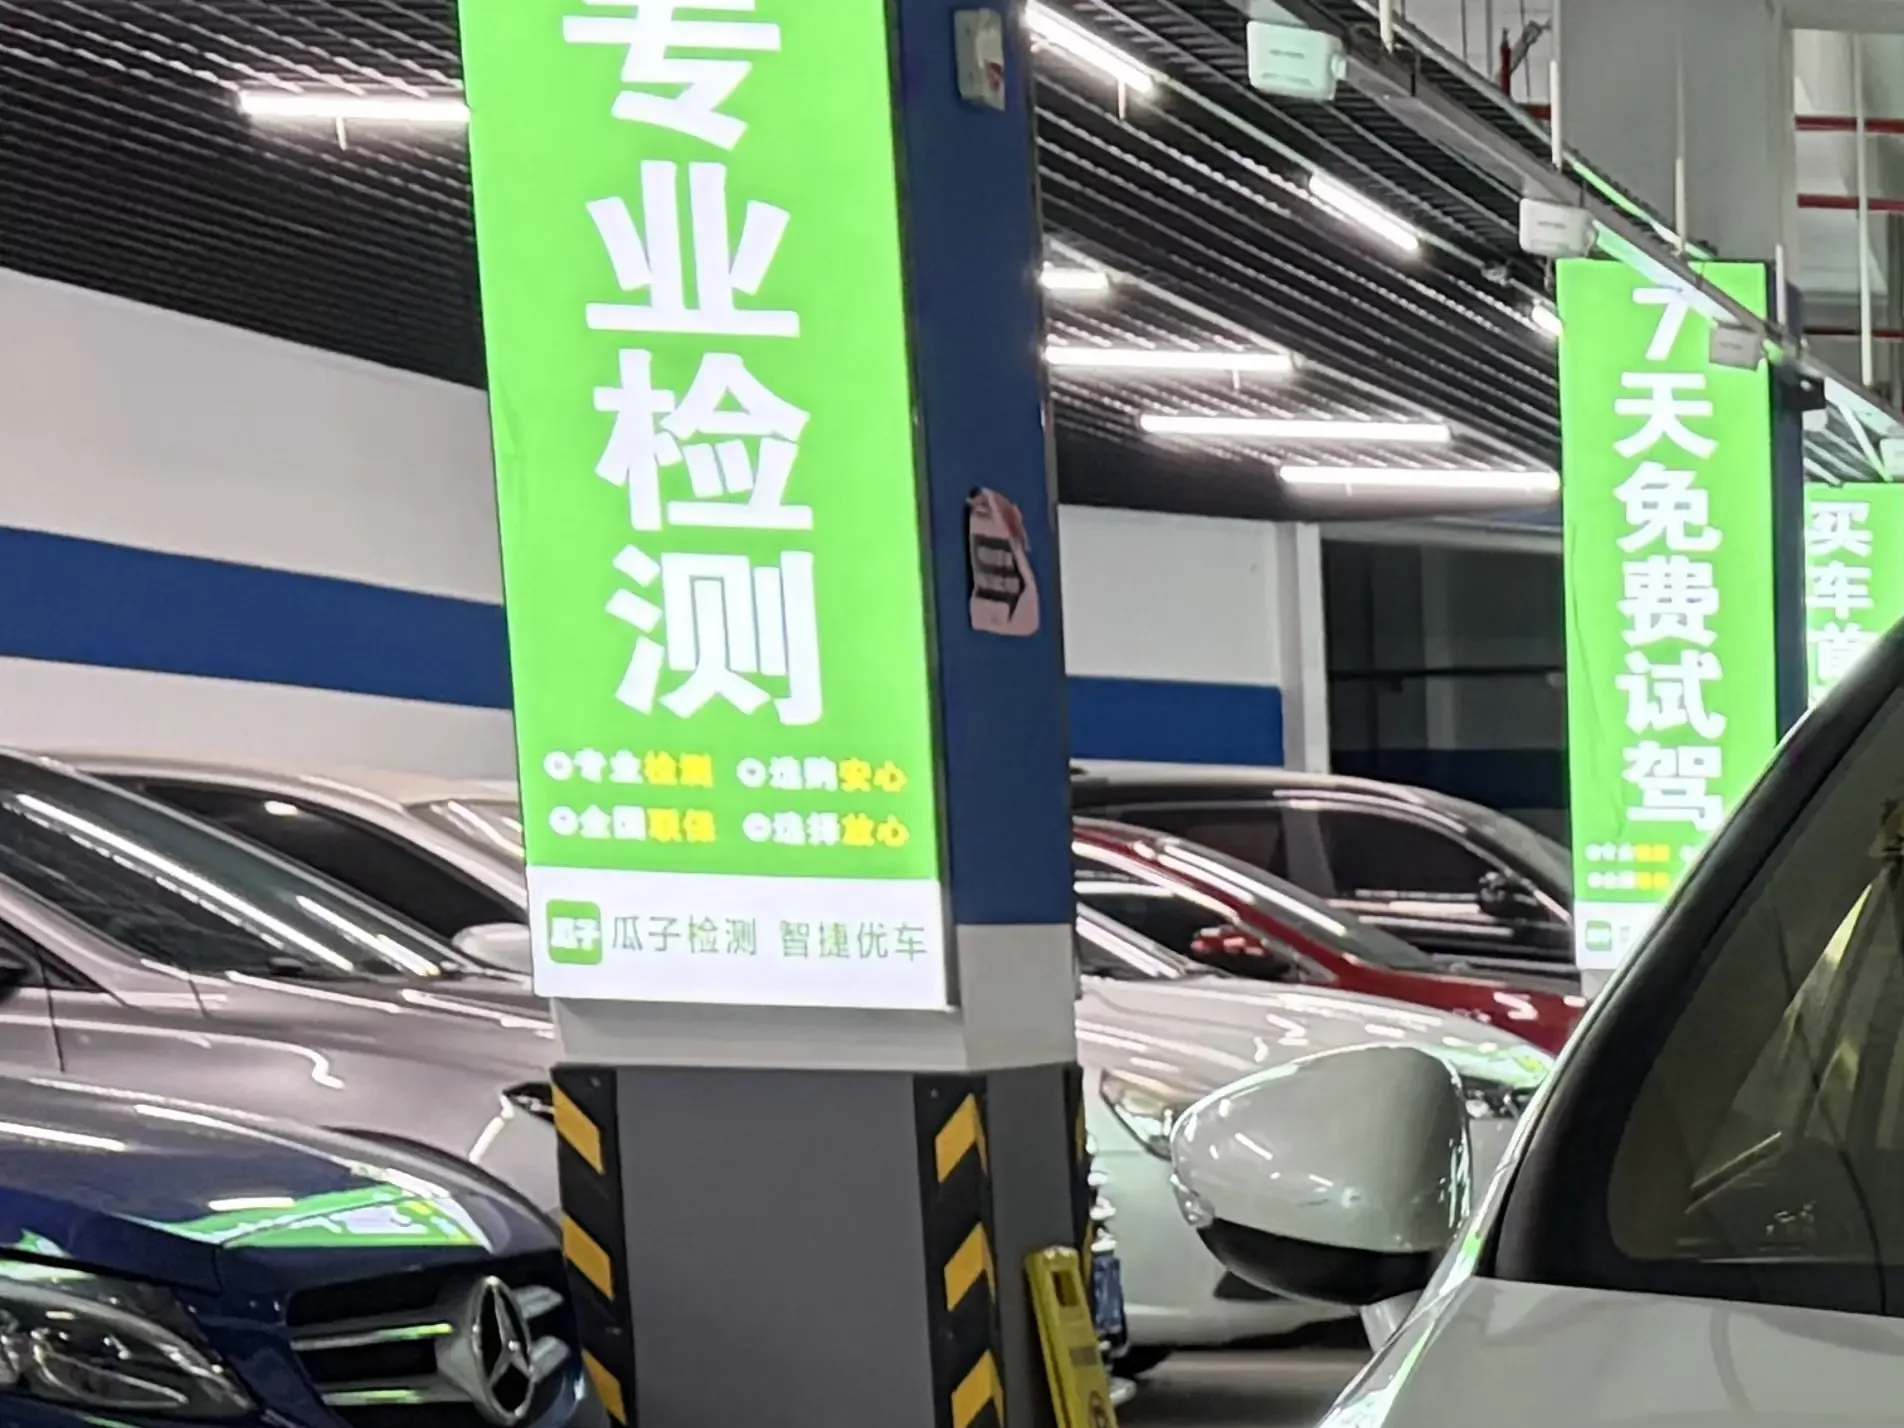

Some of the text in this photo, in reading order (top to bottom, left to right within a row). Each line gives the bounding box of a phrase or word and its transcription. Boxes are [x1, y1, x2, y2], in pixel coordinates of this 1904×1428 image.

[562, 0, 824, 726] 专业检测
[1612, 286, 1728, 833] 7天免费试驾
[611, 914, 759, 957] 瓜子检测
[778, 918, 928, 962] 智捷优车
